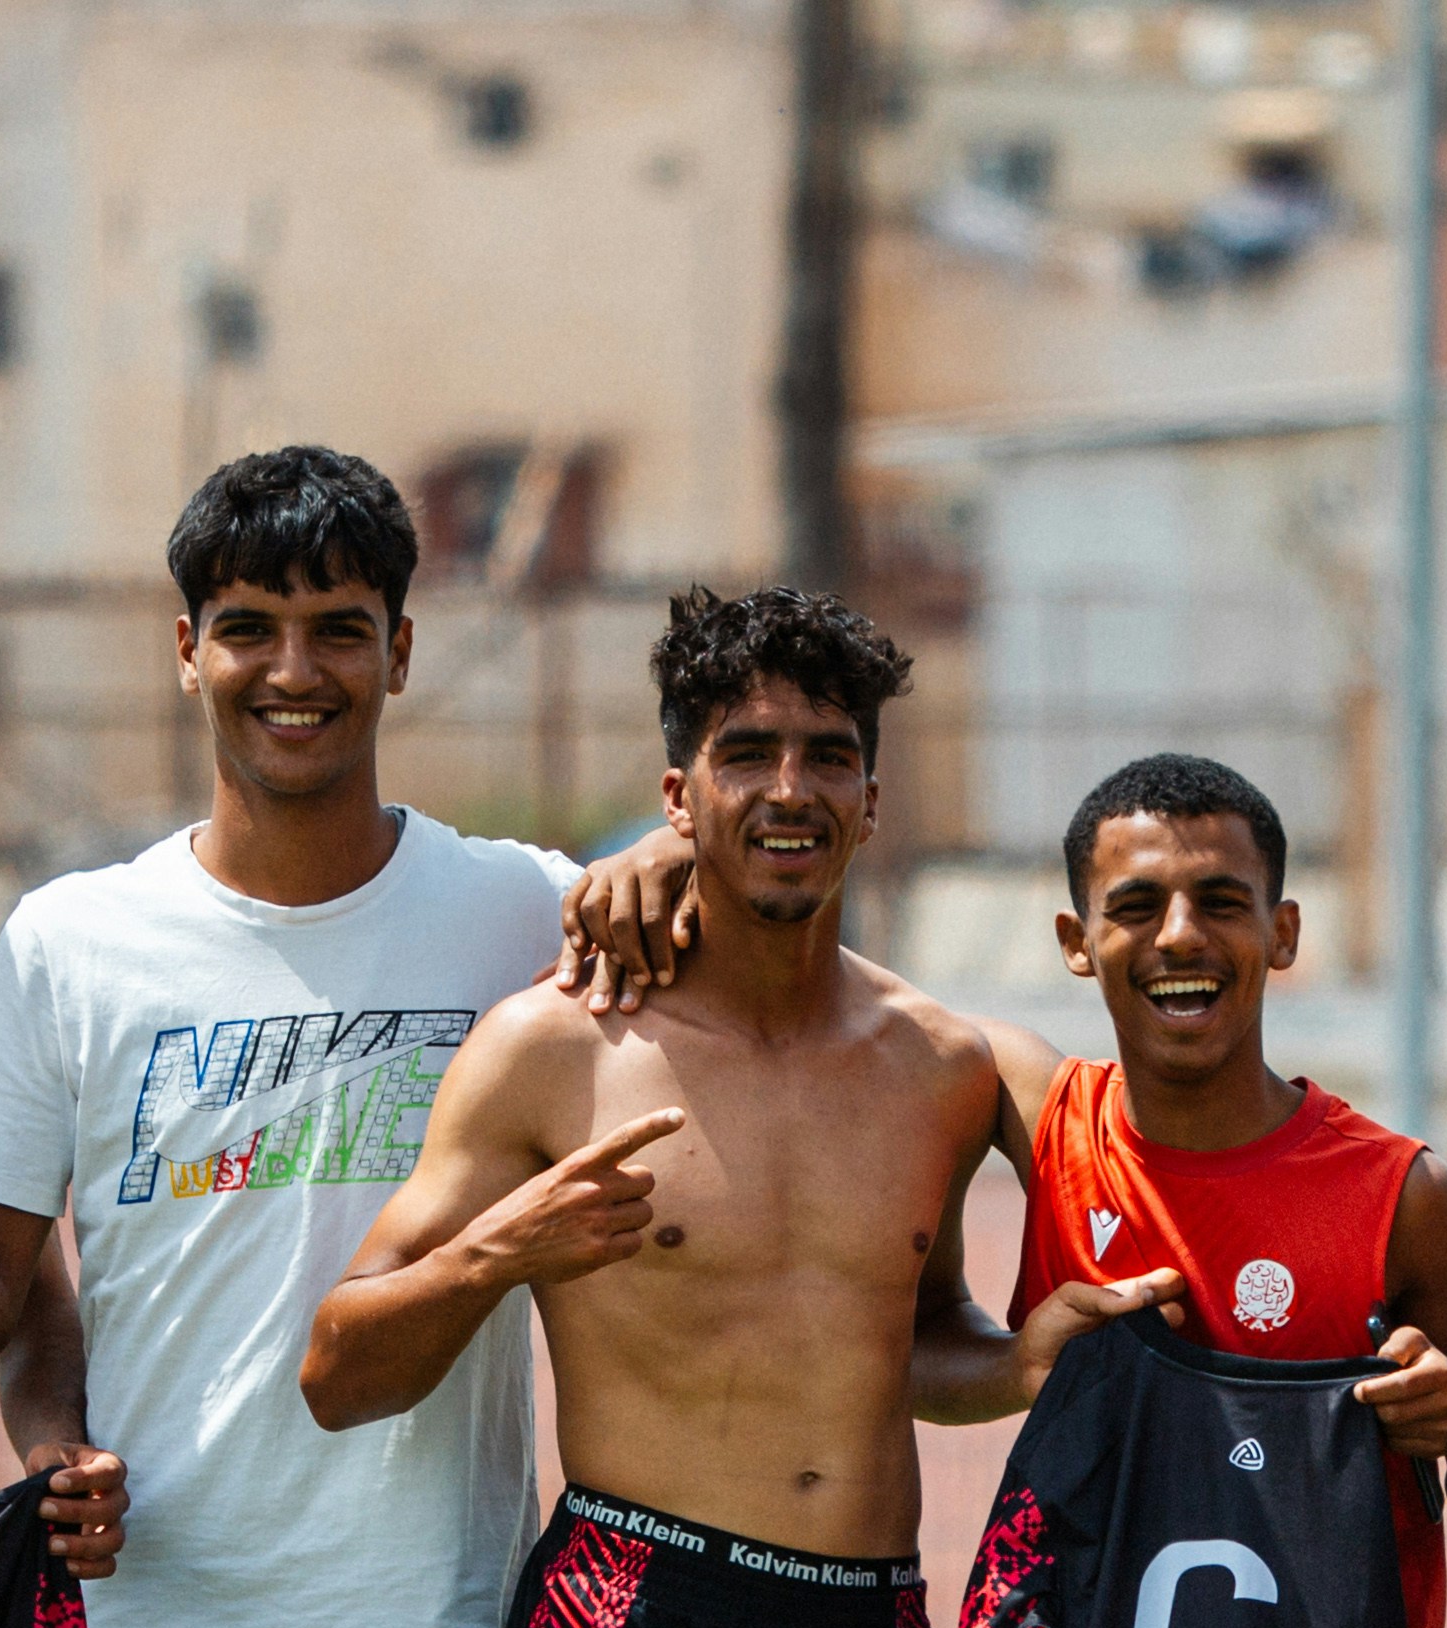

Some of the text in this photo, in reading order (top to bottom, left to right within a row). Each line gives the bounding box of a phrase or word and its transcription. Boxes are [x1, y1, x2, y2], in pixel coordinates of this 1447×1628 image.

[566, 1491, 706, 1553] Kalvim Kleim
[729, 1541, 818, 1583] Kalvim
[821, 1562, 877, 1588] Kleim
